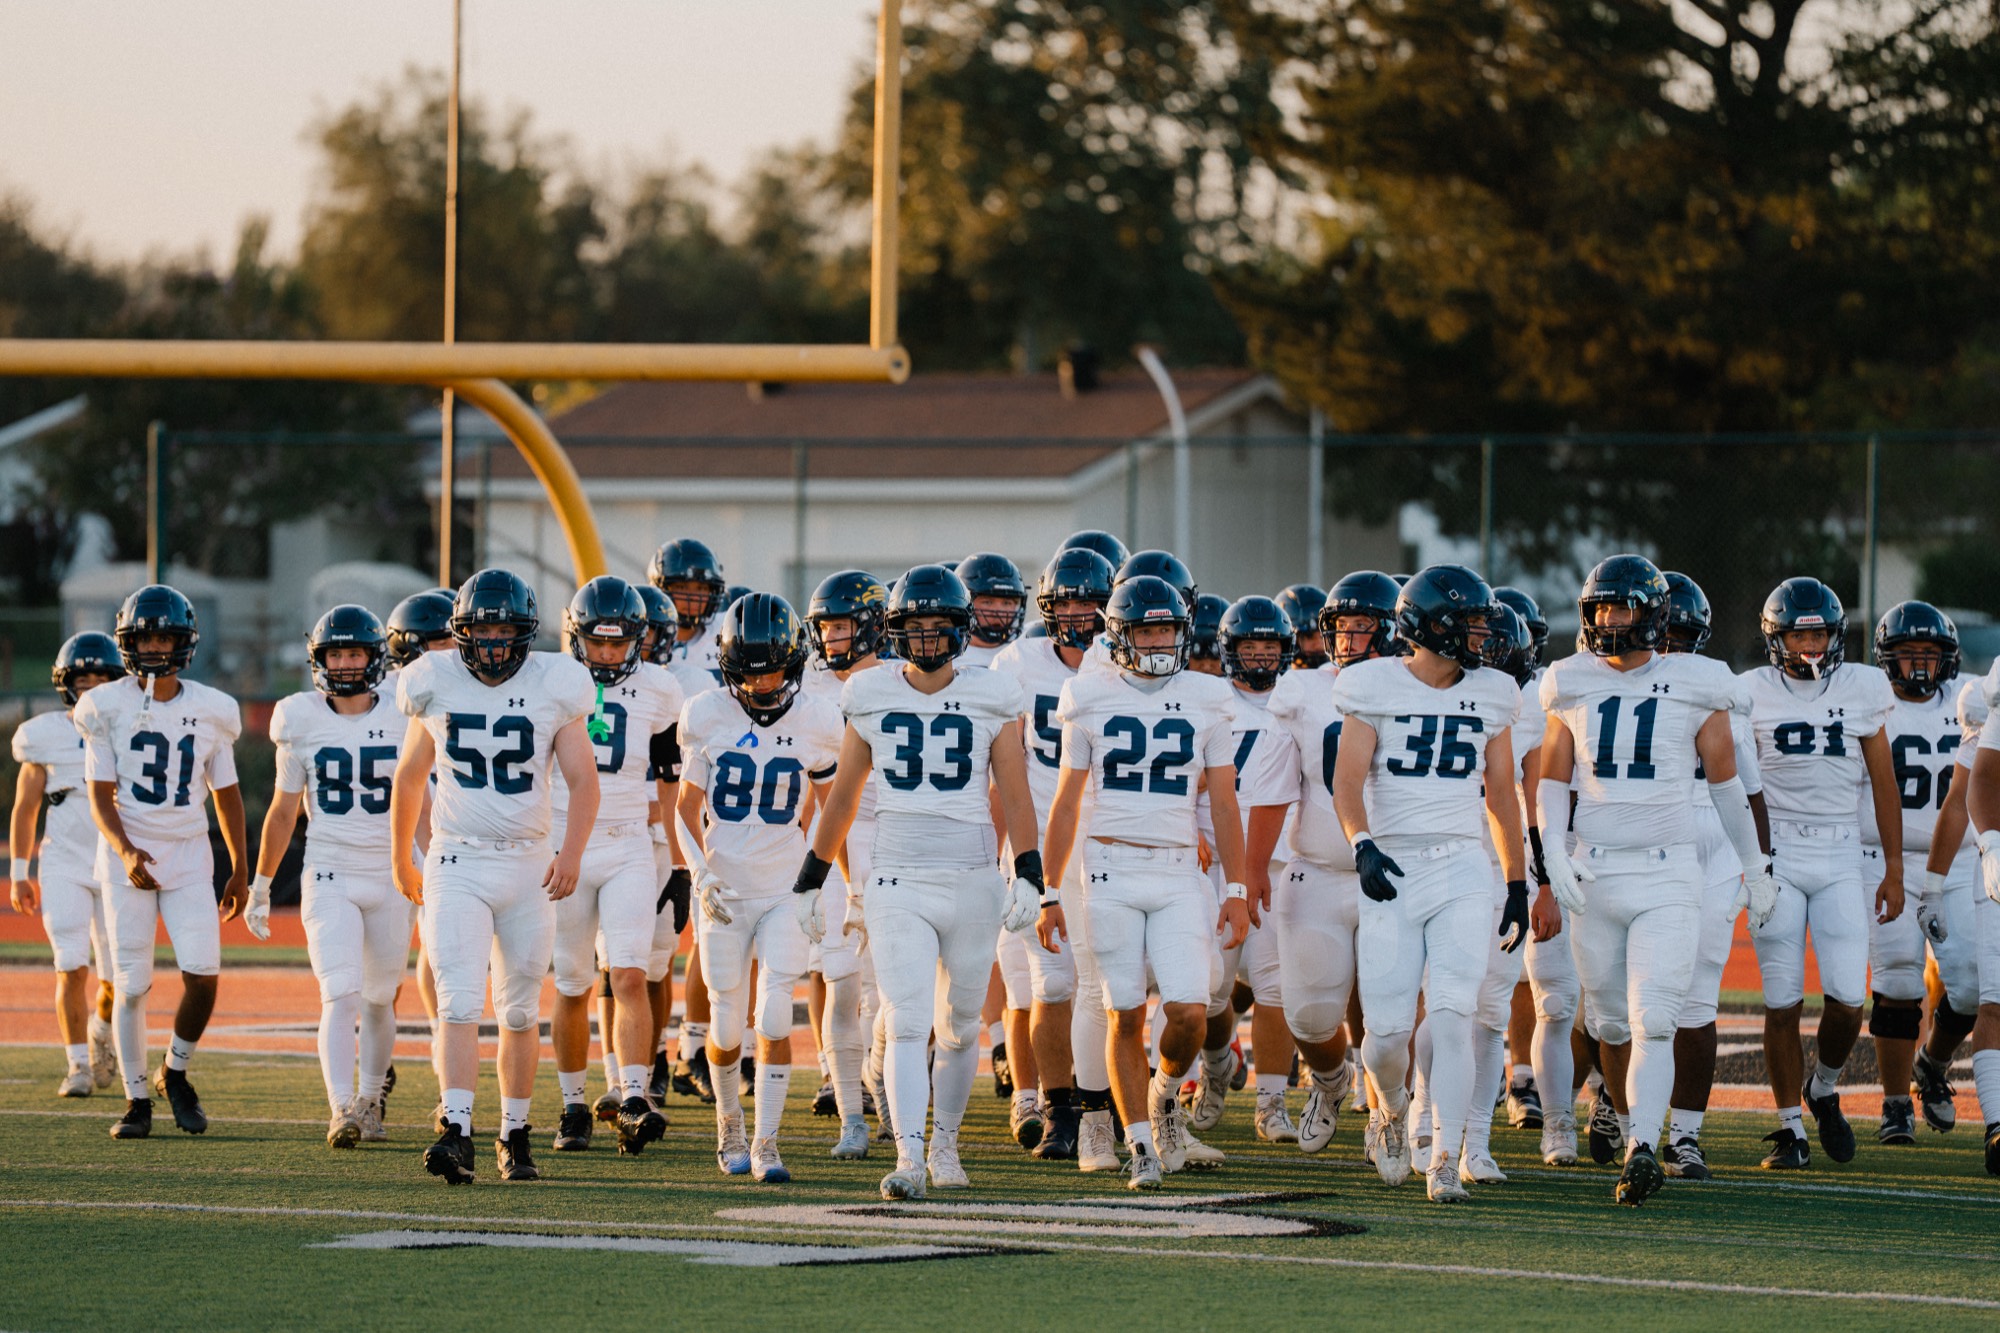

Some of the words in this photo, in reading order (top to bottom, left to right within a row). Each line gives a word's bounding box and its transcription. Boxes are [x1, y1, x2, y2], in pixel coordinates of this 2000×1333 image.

[130, 730, 195, 807] 31
[445, 712, 535, 795] 52
[881, 711, 973, 792] 33
[1103, 715, 1196, 796] 22
[1386, 714, 1484, 779] 36
[1594, 695, 1659, 780] 11
[314, 745, 398, 815] 85
[712, 750, 805, 825] 80
